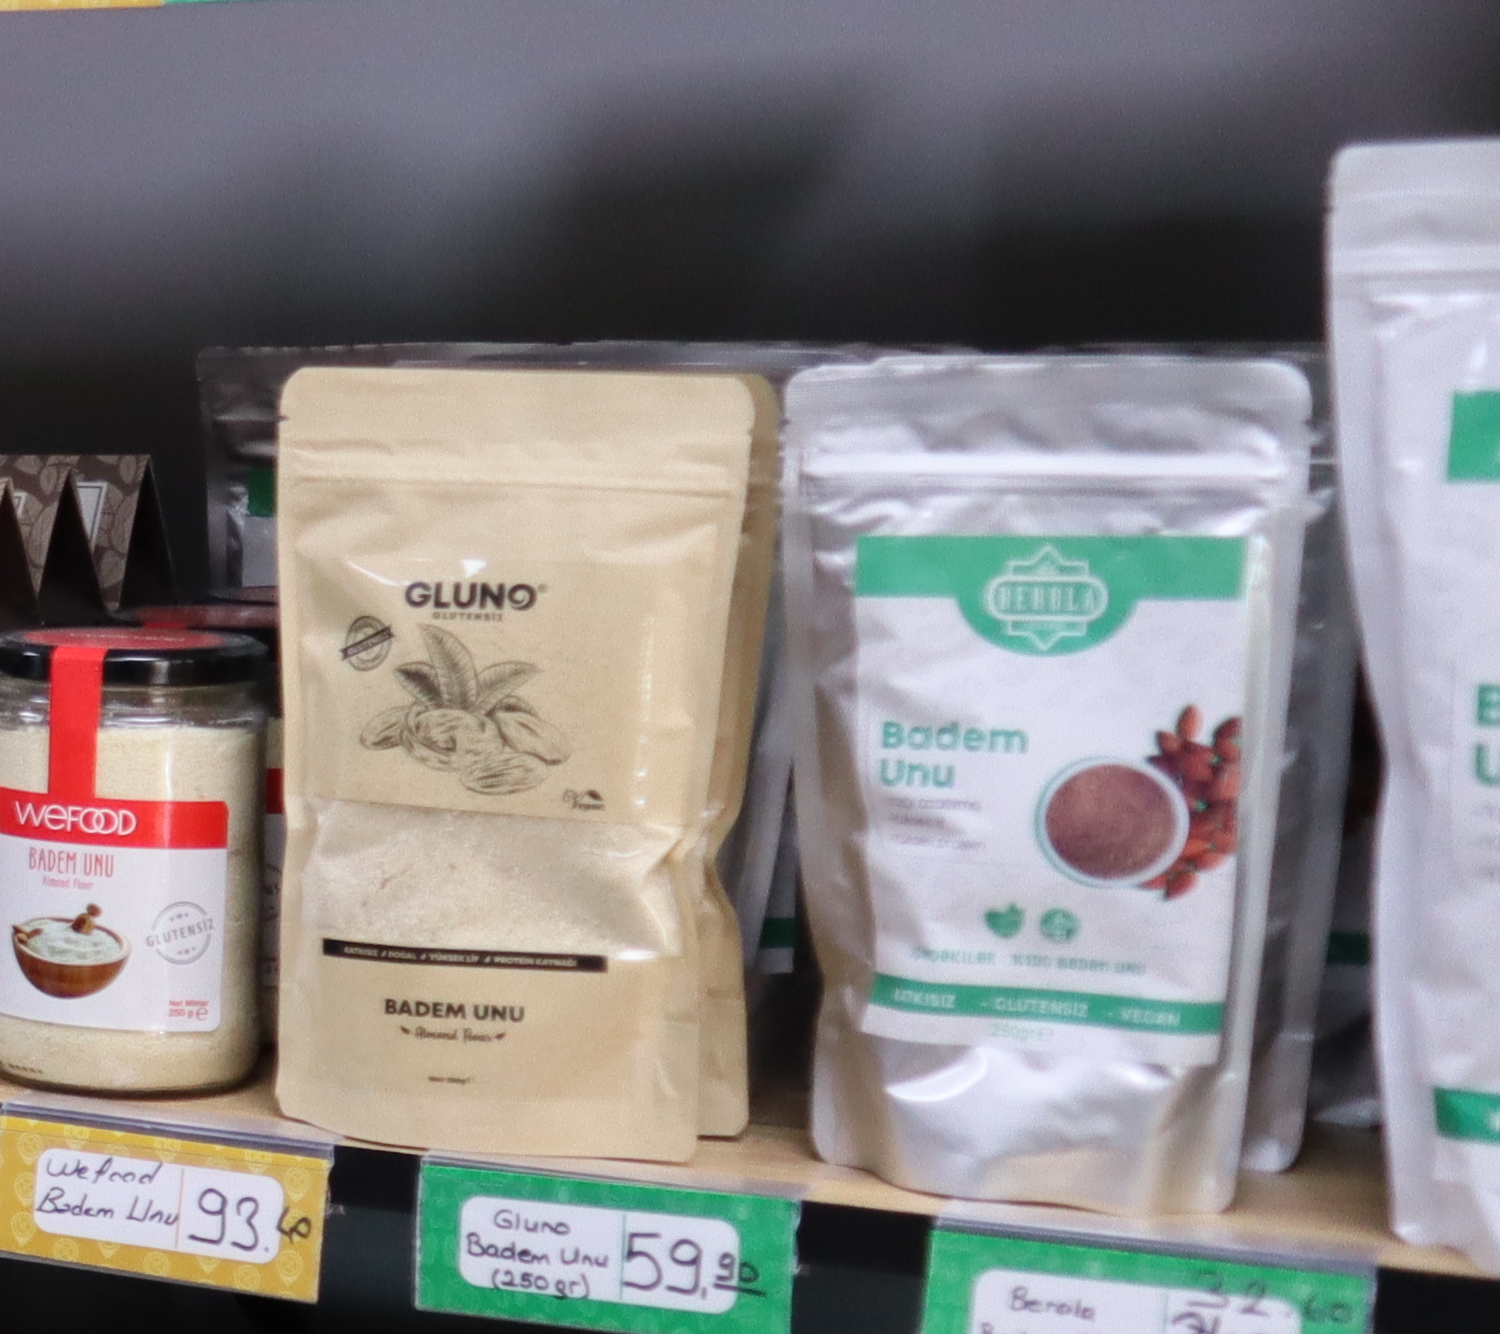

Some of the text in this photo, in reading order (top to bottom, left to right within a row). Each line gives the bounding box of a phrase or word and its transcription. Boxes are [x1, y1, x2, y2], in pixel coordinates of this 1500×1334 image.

[403, 579, 539, 615] GLUNO
[881, 720, 1029, 754] Badem
[879, 760, 956, 789] Unu
[29, 847, 114, 878] BADEM UNU
[146, 917, 215, 948] GLUTENSİZ
[383, 995, 526, 1026] BADEM UNU
[493, 1209, 571, 1238] Gluno
[466, 1233, 610, 1274] Badem Unu
